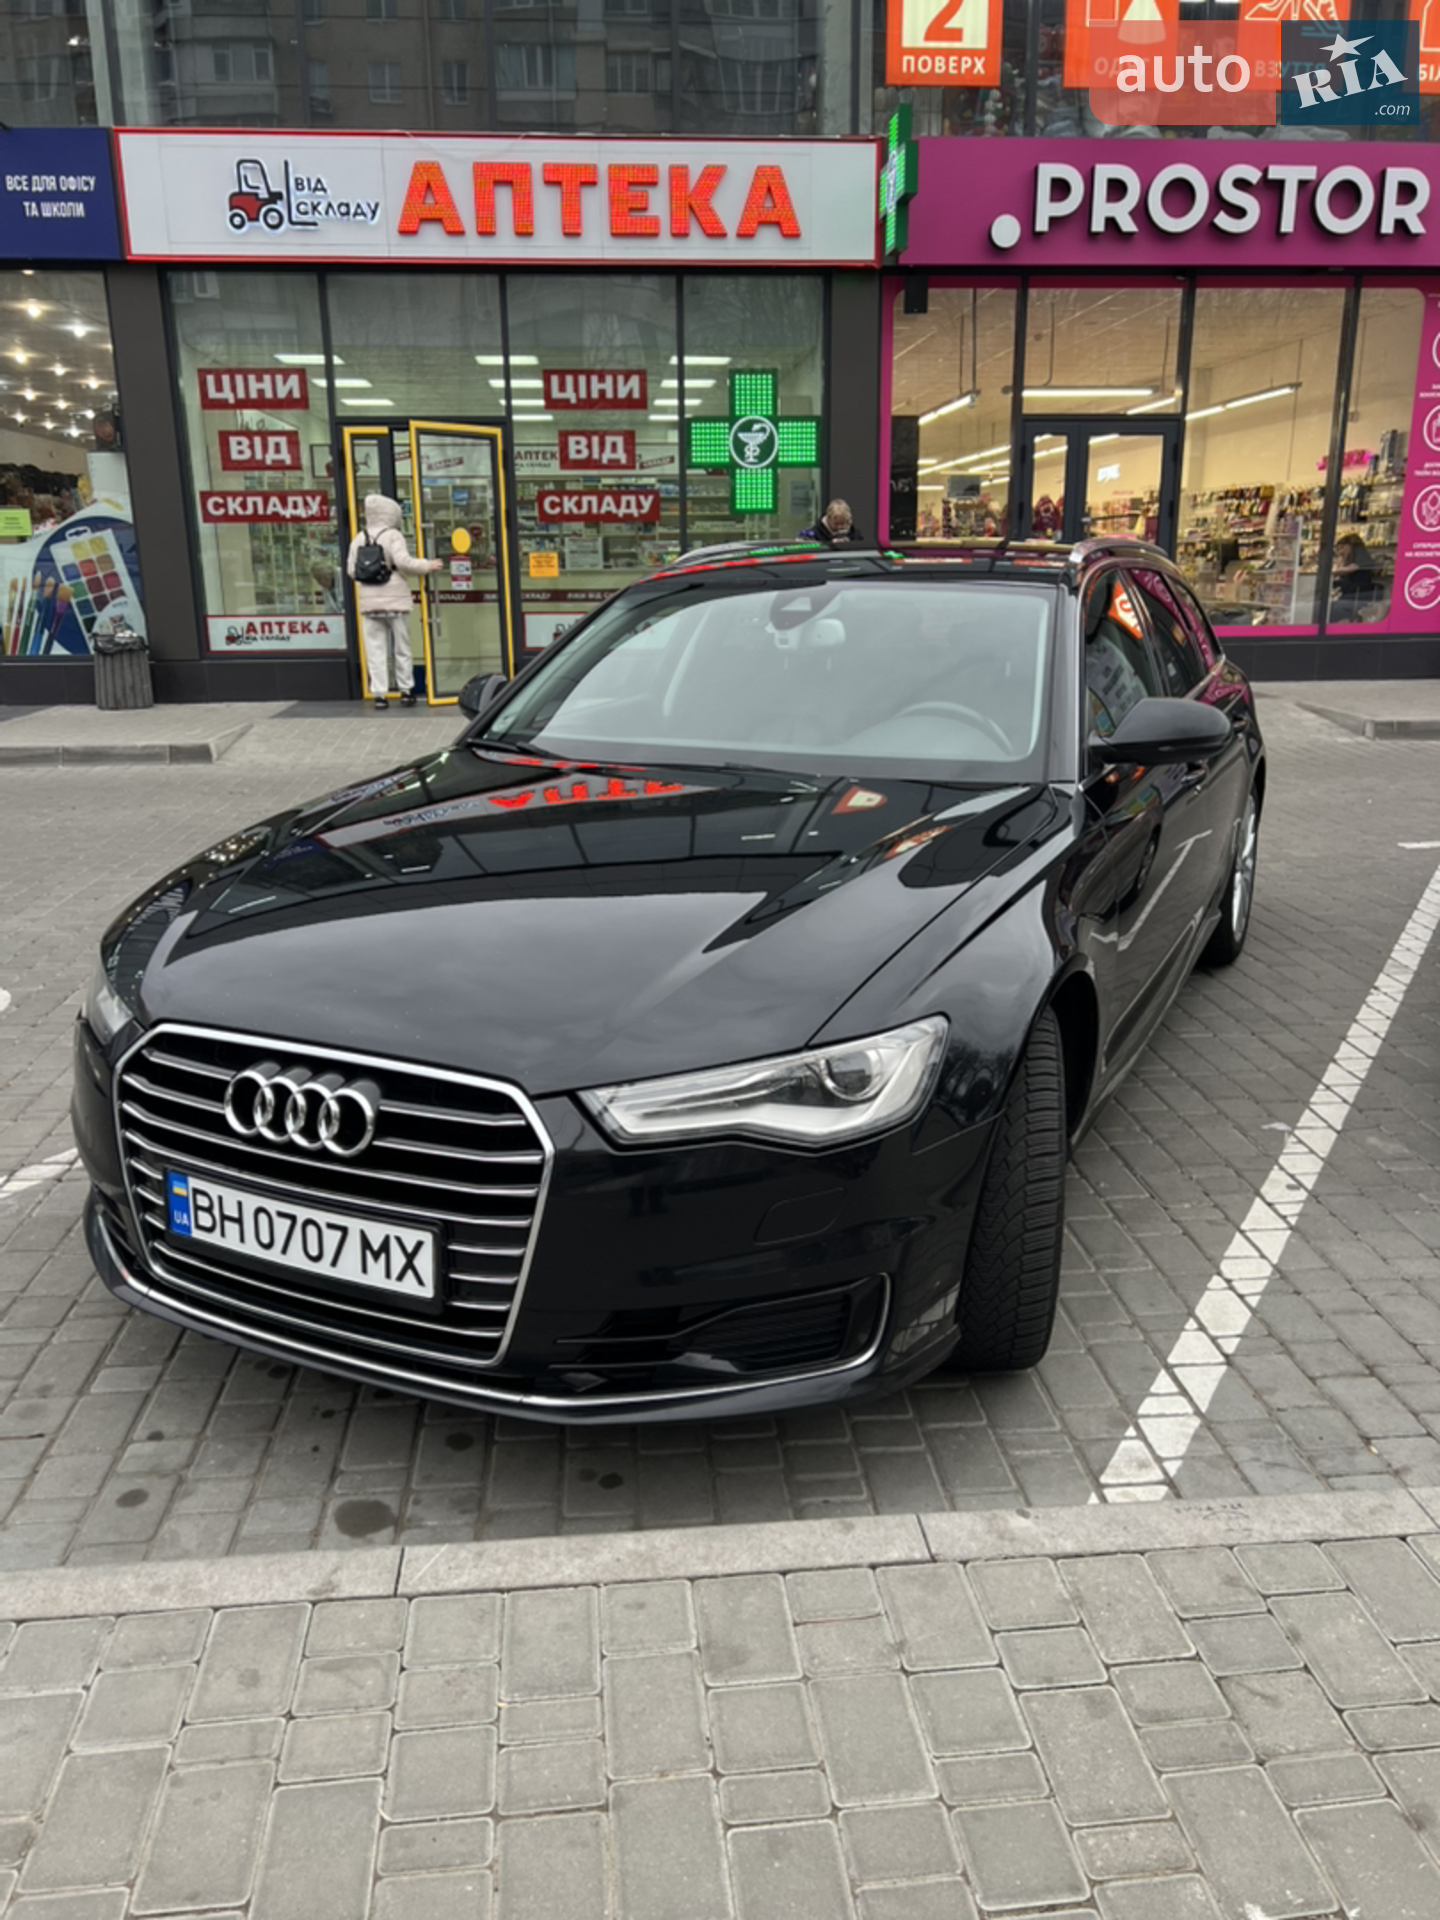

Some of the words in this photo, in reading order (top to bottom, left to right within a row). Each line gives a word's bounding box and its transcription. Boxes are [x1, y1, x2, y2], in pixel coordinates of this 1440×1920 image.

[902, 55, 986, 75] ПОВЕРХ
[5, 175, 29, 192] ВСЕ
[31, 175, 57, 193] ДЛЯ
[59, 175, 96, 192] ОФІСУ
[23, 201, 39, 217] ТА
[41, 201, 85, 217] ШКОЛИ
[397, 160, 801, 237] АПТЕКА
[205, 374, 302, 404] ЦІНИ
[550, 374, 641, 403] ЦІНИ
[228, 436, 292, 465] ВІД
[567, 435, 627, 465] ВІД
[205, 495, 322, 518] СКЛАДУ
[543, 495, 655, 517] СКЛАДУ
[245, 621, 330, 634] АПТЕКА
[174, 1209, 190, 1228] UA
[191, 1186, 245, 1244] BH
[253, 1206, 349, 1268] 0707
[360, 1228, 426, 1287] MX
